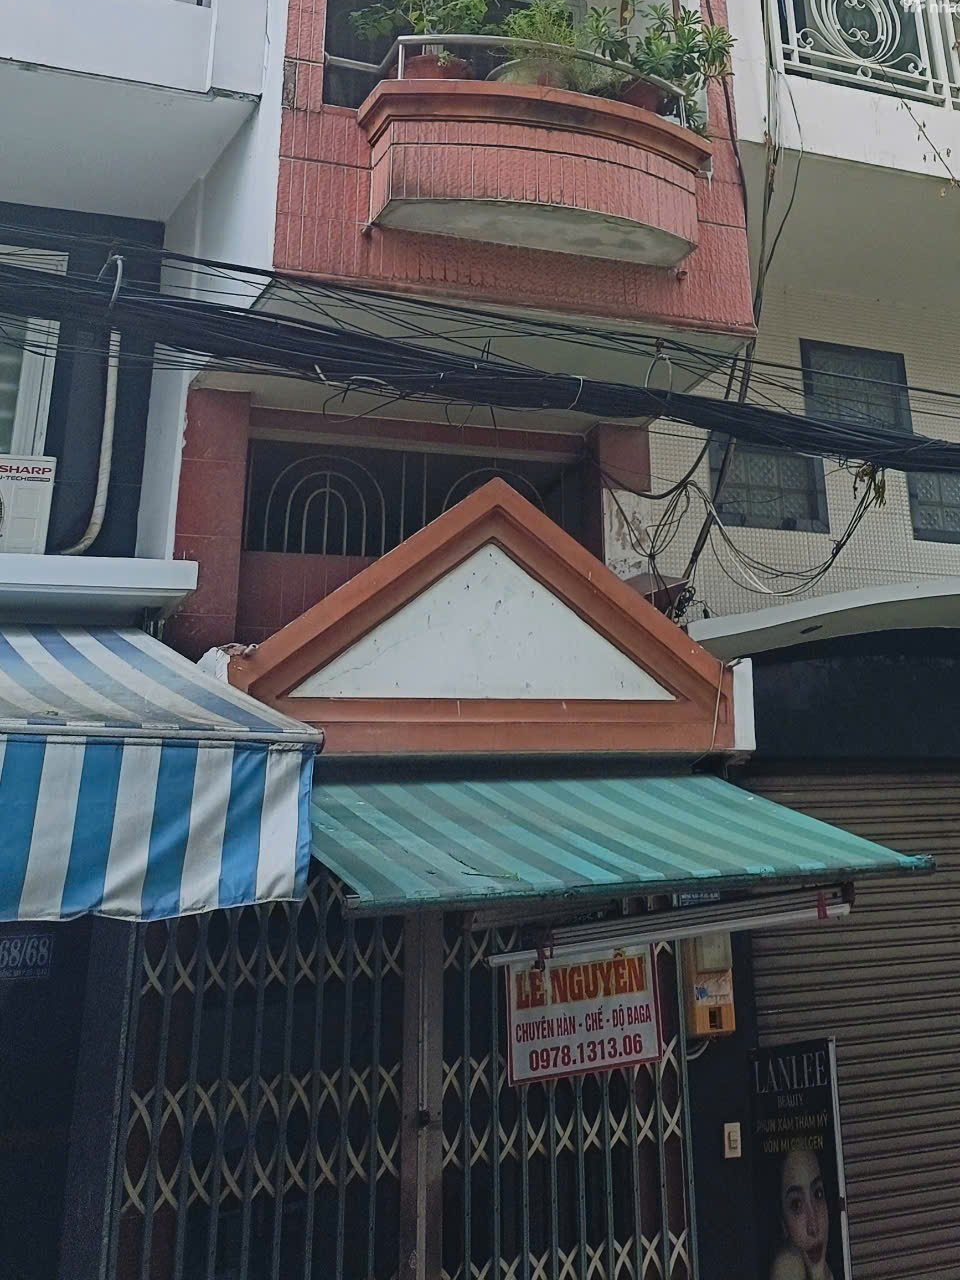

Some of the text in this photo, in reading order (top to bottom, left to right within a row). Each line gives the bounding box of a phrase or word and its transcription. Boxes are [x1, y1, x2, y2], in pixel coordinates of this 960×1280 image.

[0, 465, 52, 475] SHARP
[515, 1016, 554, 1043] CHUYÊN
[556, 1013, 576, 1036] HÀN
[585, 1005, 604, 1032] CHẾ
[612, 1004, 625, 1031] ĐỘ
[626, 1004, 652, 1025] BAGA
[528, 1033, 643, 1071] 0978.1313.06
[753, 1050, 829, 1094] LANLEE
